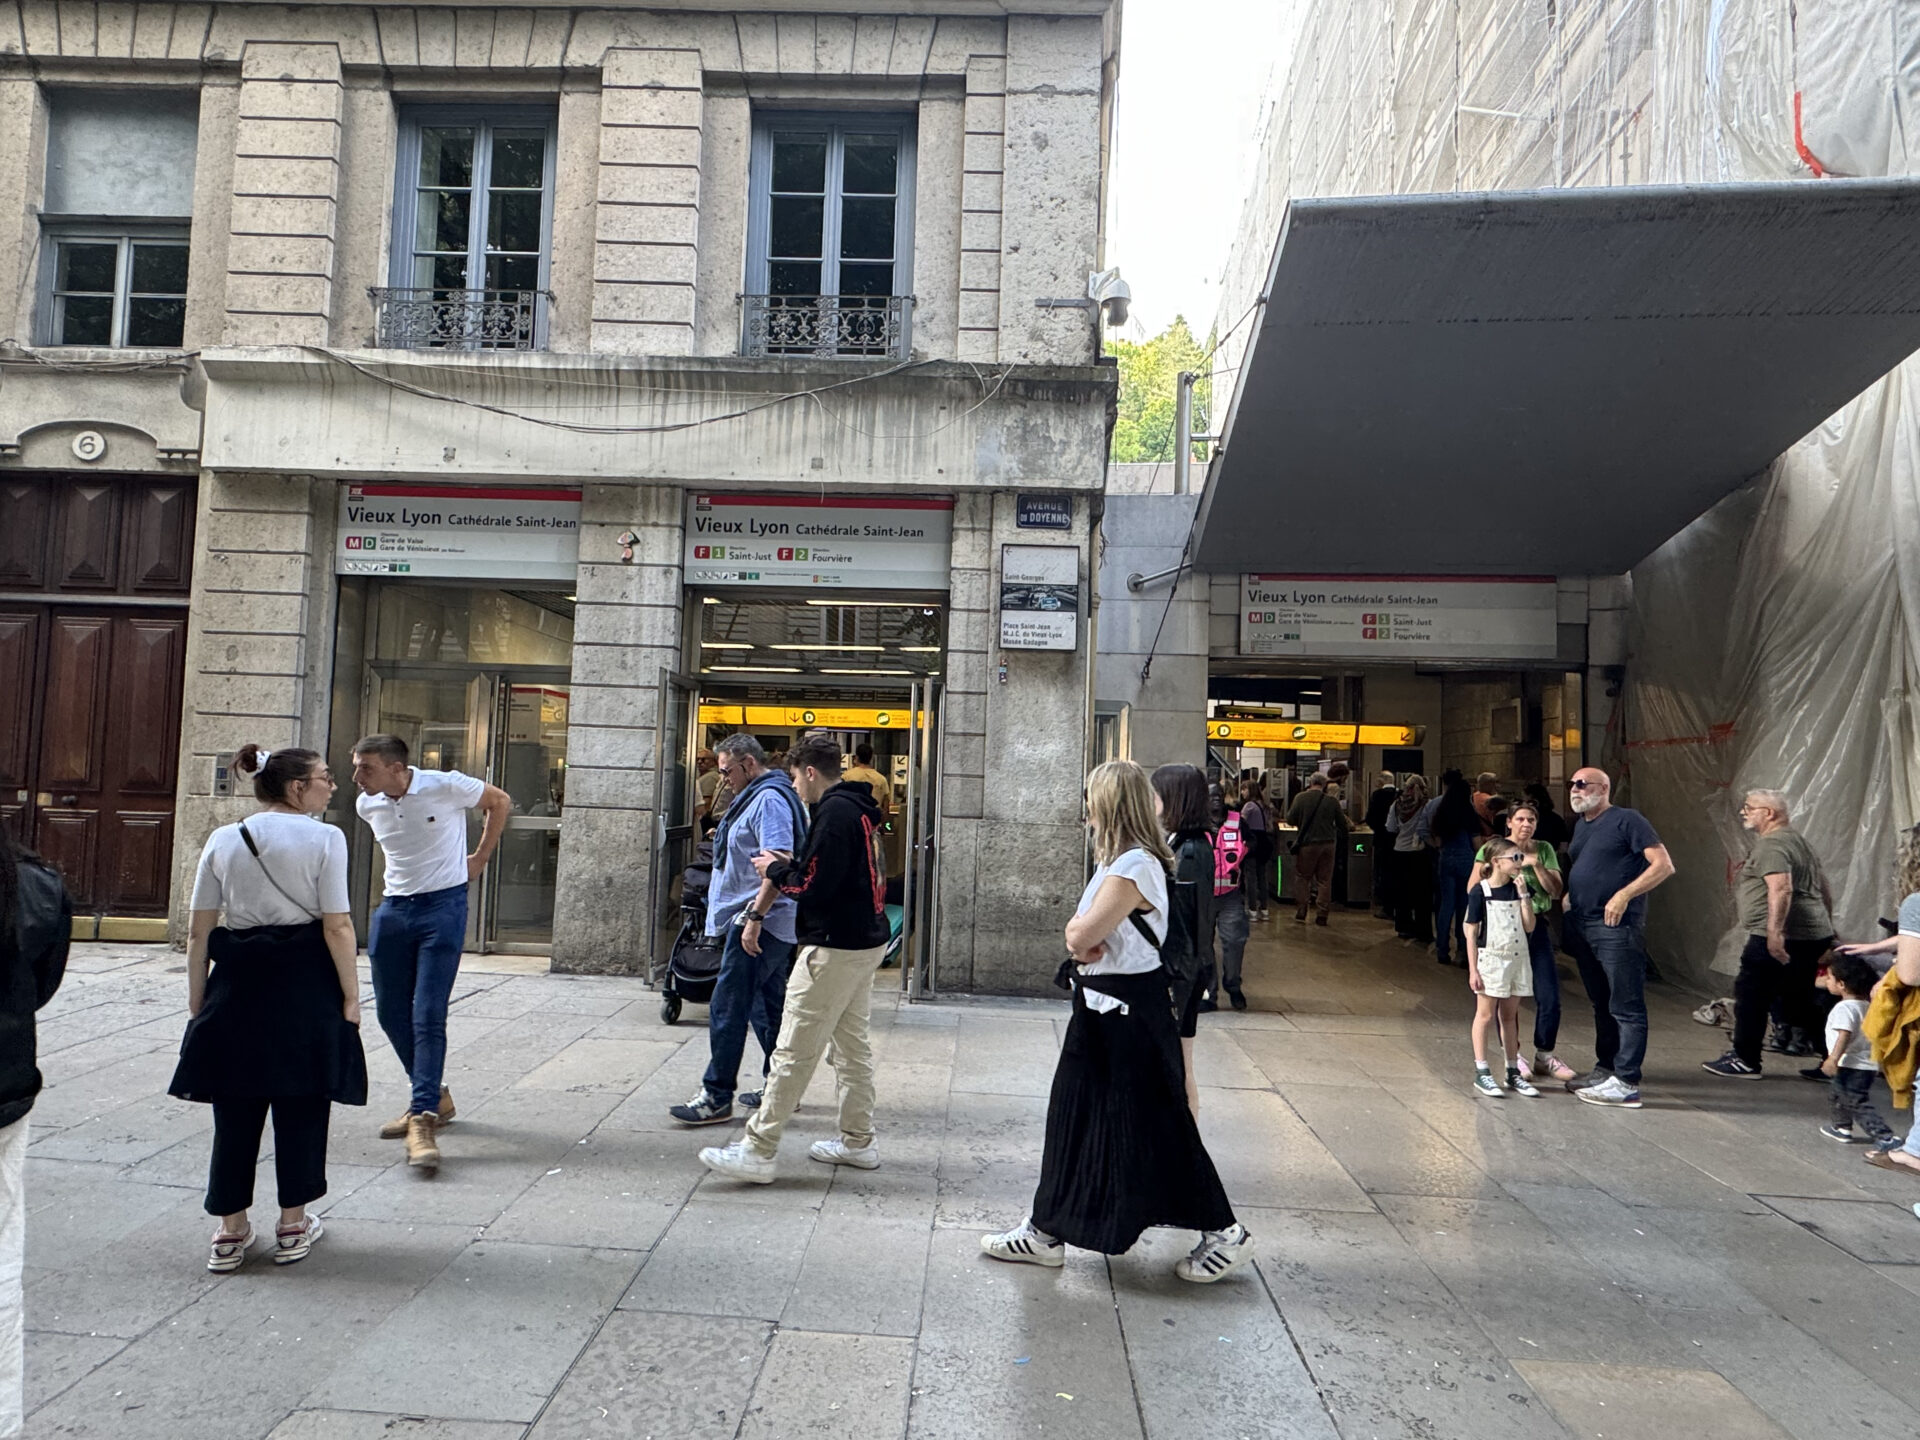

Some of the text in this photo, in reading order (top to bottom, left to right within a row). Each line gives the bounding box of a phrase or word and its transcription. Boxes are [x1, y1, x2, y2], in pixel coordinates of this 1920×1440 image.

[78, 436, 95, 454] 6
[1026, 502, 1063, 511] AVENUE
[348, 507, 576, 529] Vieux Lyon Cathédrale Saint-Jean
[1030, 513, 1067, 523] DOYENNE
[695, 517, 924, 538] Vieux Lyon Cathédrale Saint-Jean
[380, 536, 395, 544] Gare
[397, 536, 405, 544] de
[729, 551, 772, 561] Saint-Just
[812, 553, 852, 564] Fourvière
[1248, 590, 1438, 606] Vieux Lyon Cathédrale Saint-Jean
[1393, 618, 1432, 626] Saint-Just
[1394, 632, 1431, 640] Fourvière
